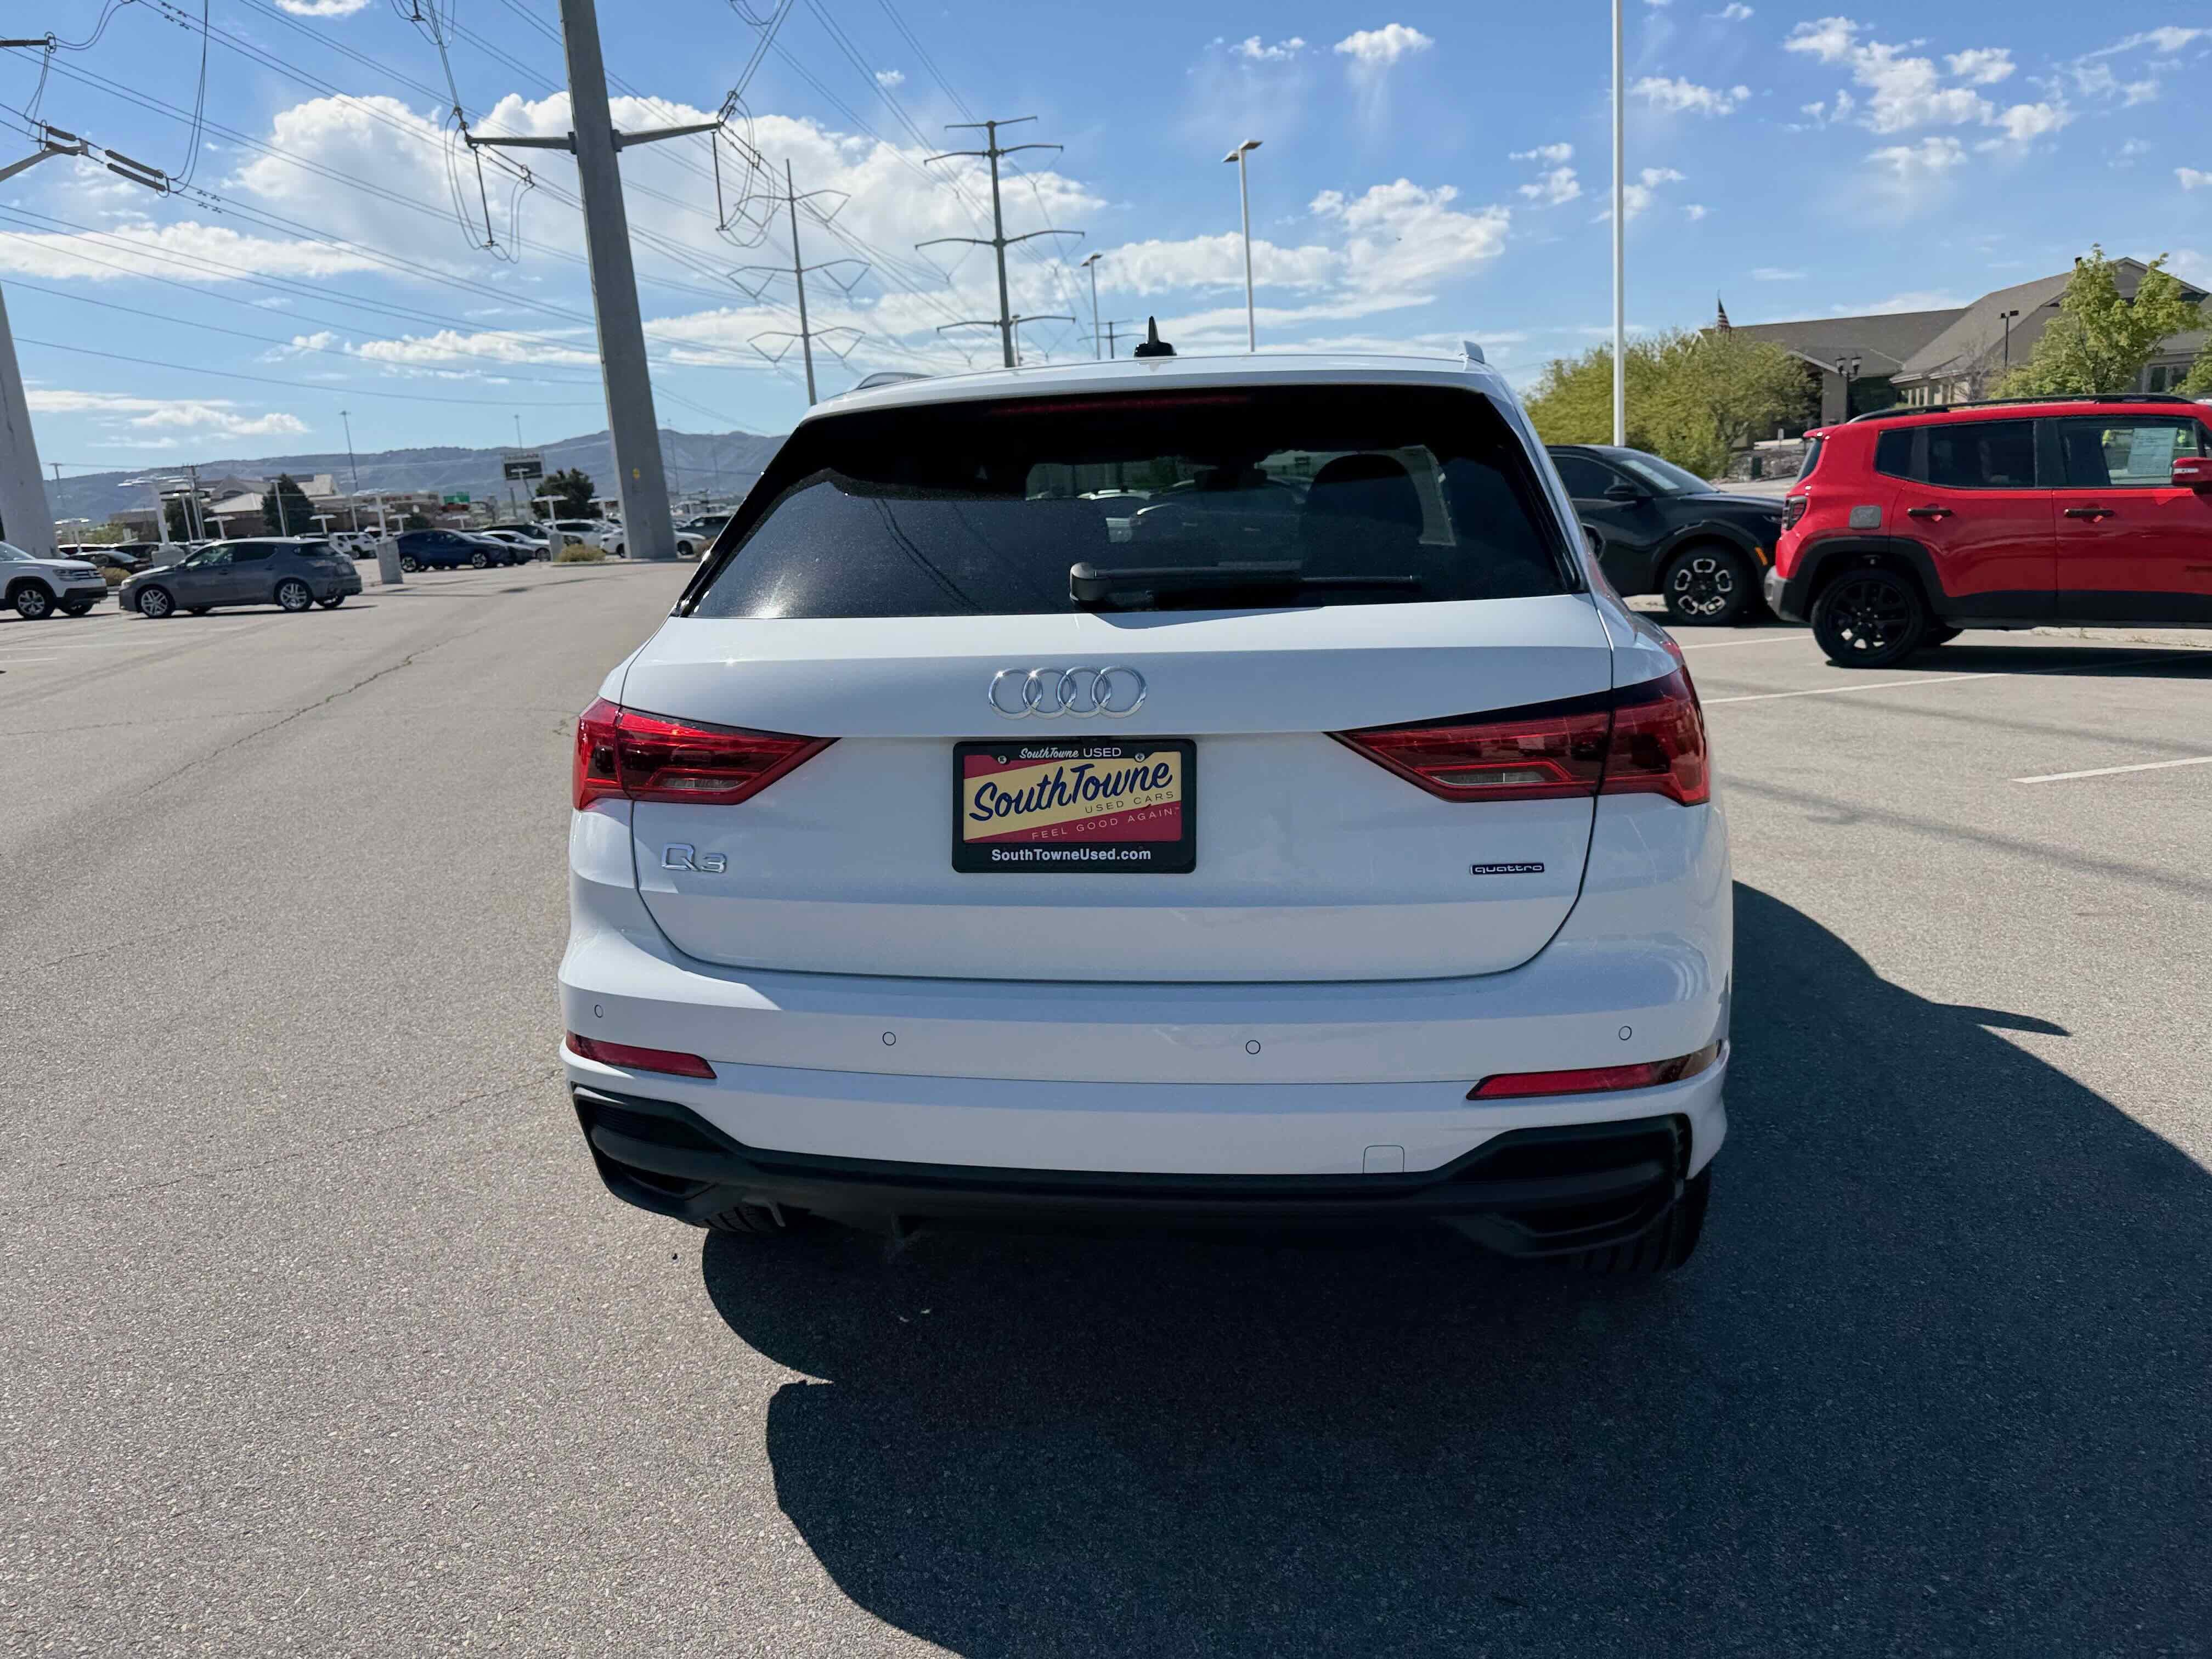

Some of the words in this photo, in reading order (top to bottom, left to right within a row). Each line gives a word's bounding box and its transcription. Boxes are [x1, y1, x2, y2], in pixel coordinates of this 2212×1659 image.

[1019, 747, 1079, 759] SouthTowne
[1083, 748, 1121, 757] USED
[969, 762, 1172, 821] SouthTowne
[1085, 800, 1124, 813] USED
[1133, 791, 1173, 804] CARS
[1031, 827, 1068, 840] FEEL
[1076, 818, 1118, 832] GOOD
[661, 842, 727, 873] Q3
[991, 849, 1151, 861] SouthTowneUsed.com
[1475, 865, 1543, 873] quattro
